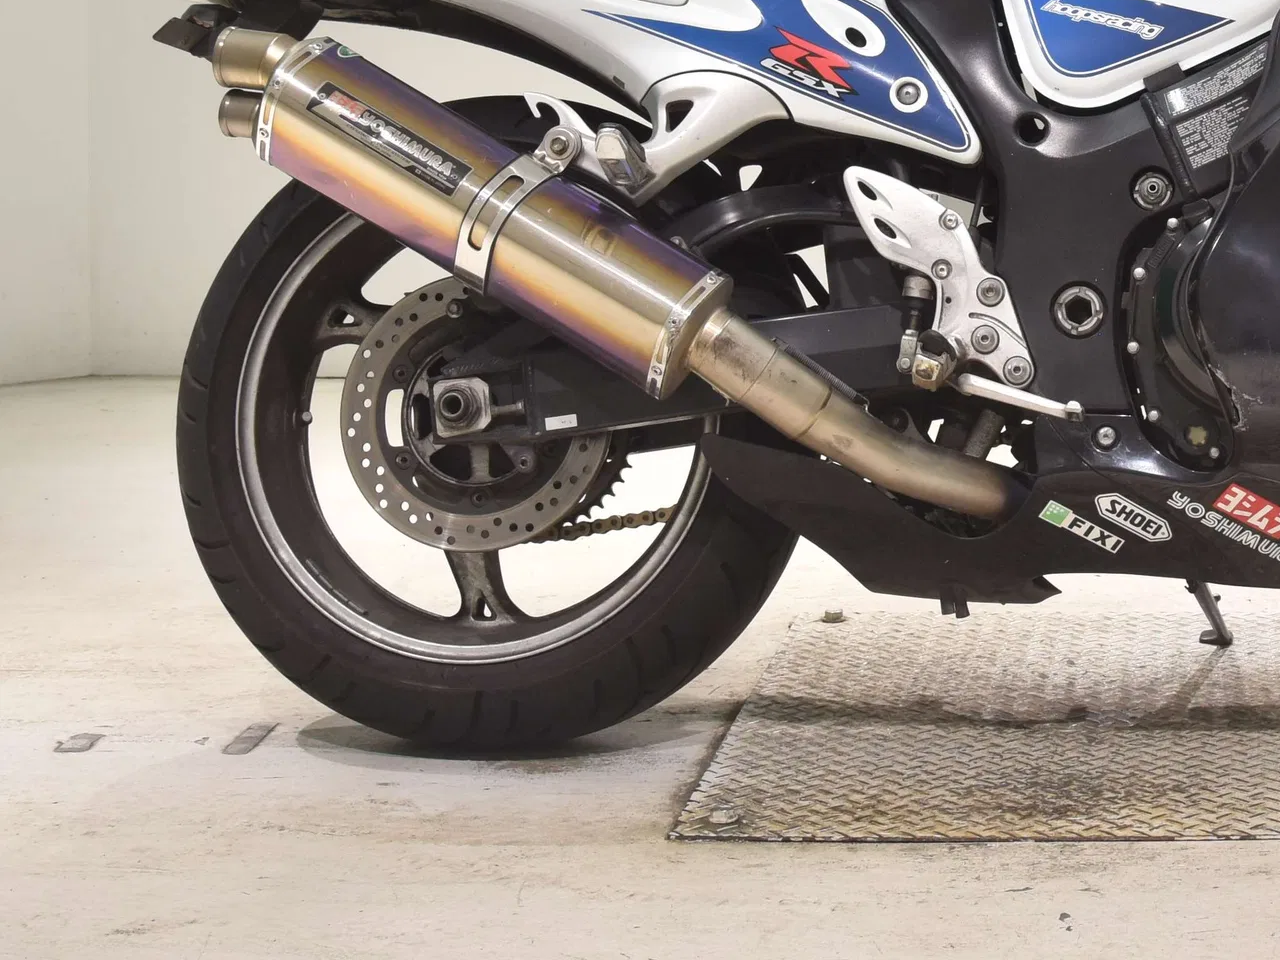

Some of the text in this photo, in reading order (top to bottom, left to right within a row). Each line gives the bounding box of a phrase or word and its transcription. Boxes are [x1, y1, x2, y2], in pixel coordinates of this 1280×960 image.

[760, 57, 849, 98] GSX
[772, 26, 852, 91] R
[358, 111, 454, 177] YOSHIMURA
[1067, 516, 1121, 552] FIXI
[1105, 499, 1163, 537] SHOEI
